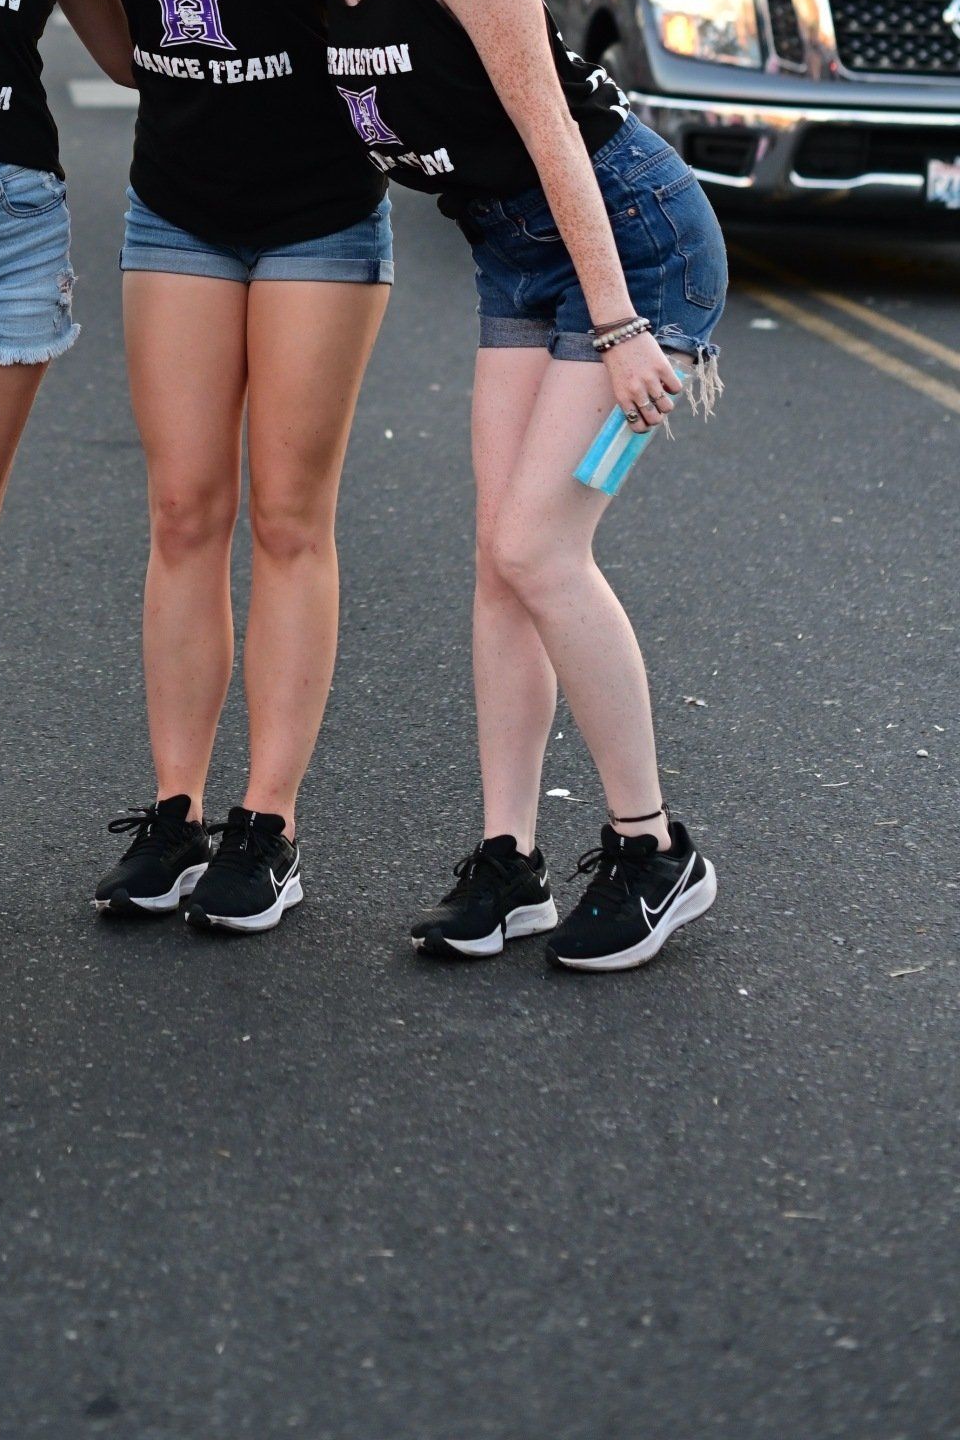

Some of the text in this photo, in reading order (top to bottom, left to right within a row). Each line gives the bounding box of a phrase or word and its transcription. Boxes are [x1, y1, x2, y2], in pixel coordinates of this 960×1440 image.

[133, 44, 293, 85] DANCE TEAM
[326, 43, 413, 76] RMISTON
